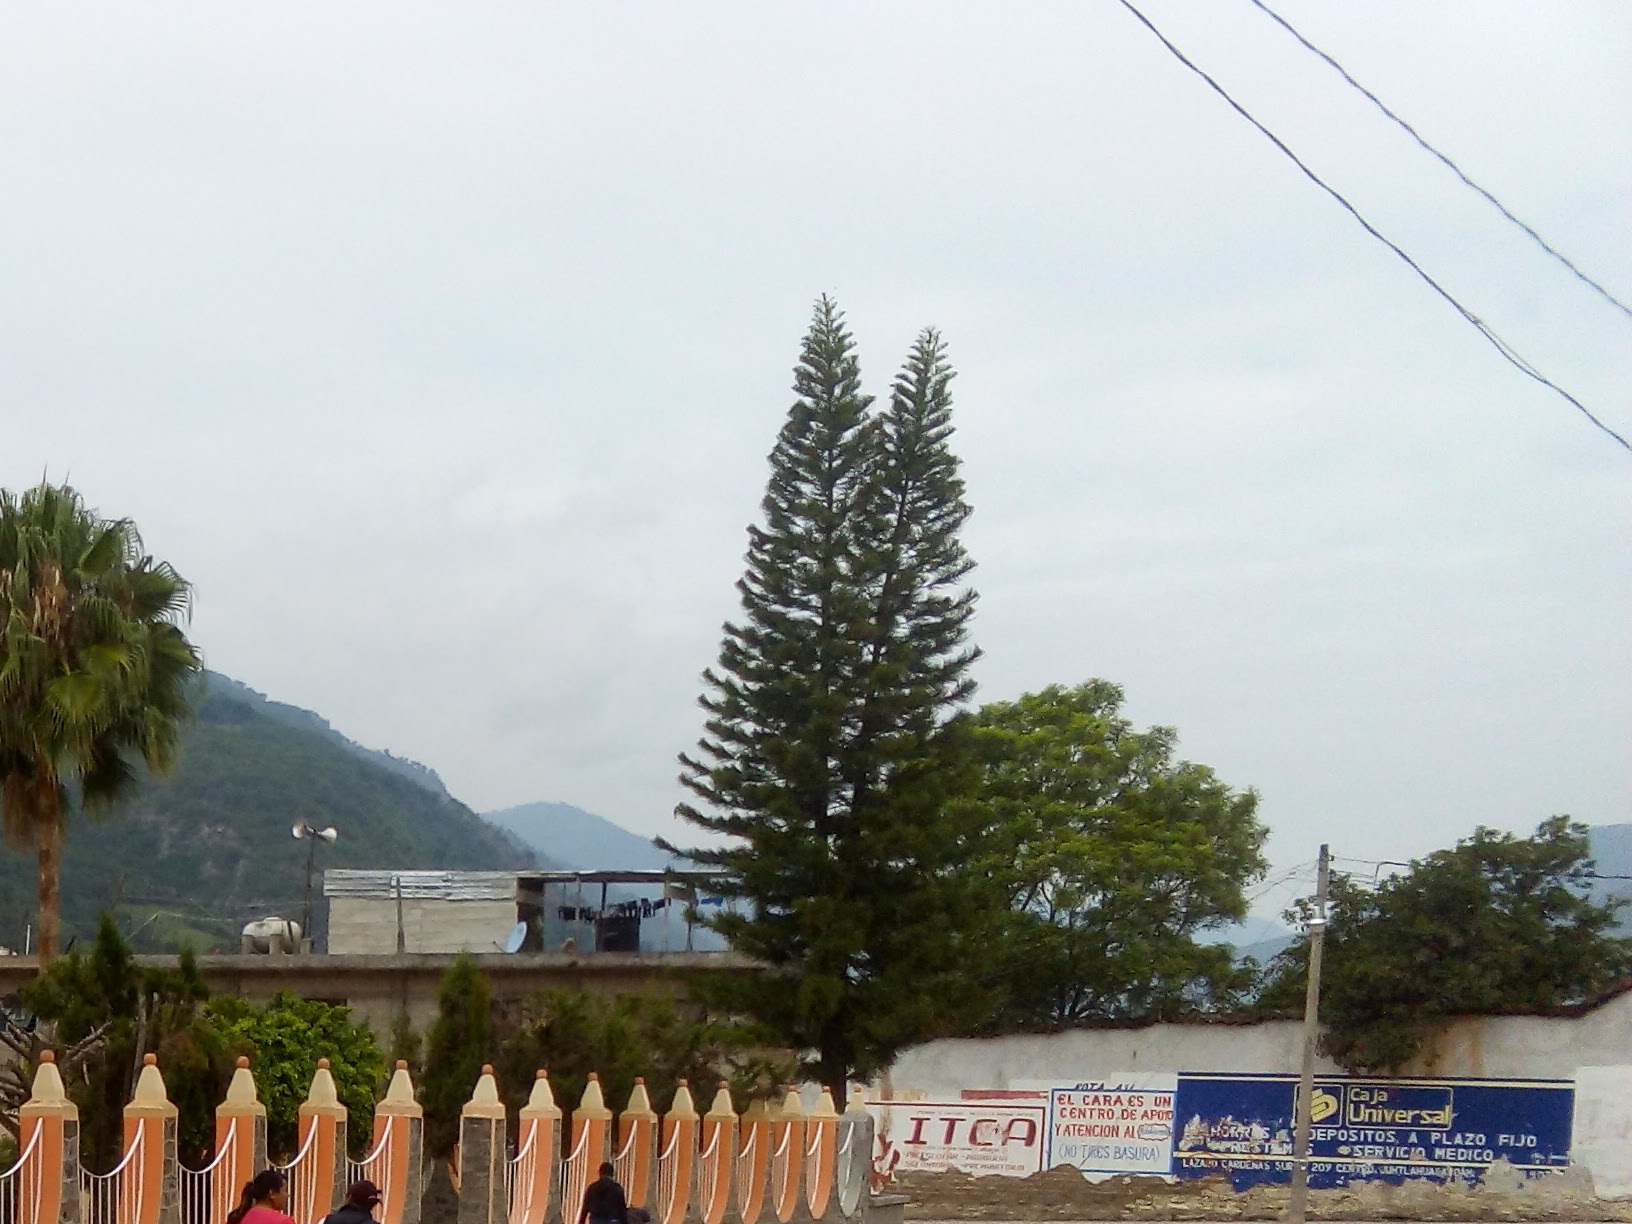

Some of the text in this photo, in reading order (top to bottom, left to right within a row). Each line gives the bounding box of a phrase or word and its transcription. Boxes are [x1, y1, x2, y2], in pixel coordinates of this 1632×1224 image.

[1058, 1094, 1171, 1107] EL CARA ES UN
[1350, 1088, 1388, 1103] Caja
[1059, 1107, 1115, 1120] CENTRO
[1120, 1109, 1137, 1120] DE
[1349, 1103, 1450, 1124] Universal
[903, 1117, 1037, 1147] ITCA
[1055, 1123, 1061, 1136] Y
[1063, 1124, 1120, 1137] ATENCION
[1124, 1126, 1135, 1138] AL
[1408, 1131, 1418, 1143] A
[1431, 1132, 1486, 1146] PLAZO
[1498, 1134, 1537, 1147] FIJO
[1081, 1145, 1110, 1158] TIRES
[1114, 1145, 1160, 1161] BASURA)
[1435, 1148, 1494, 1161] MEDICO
